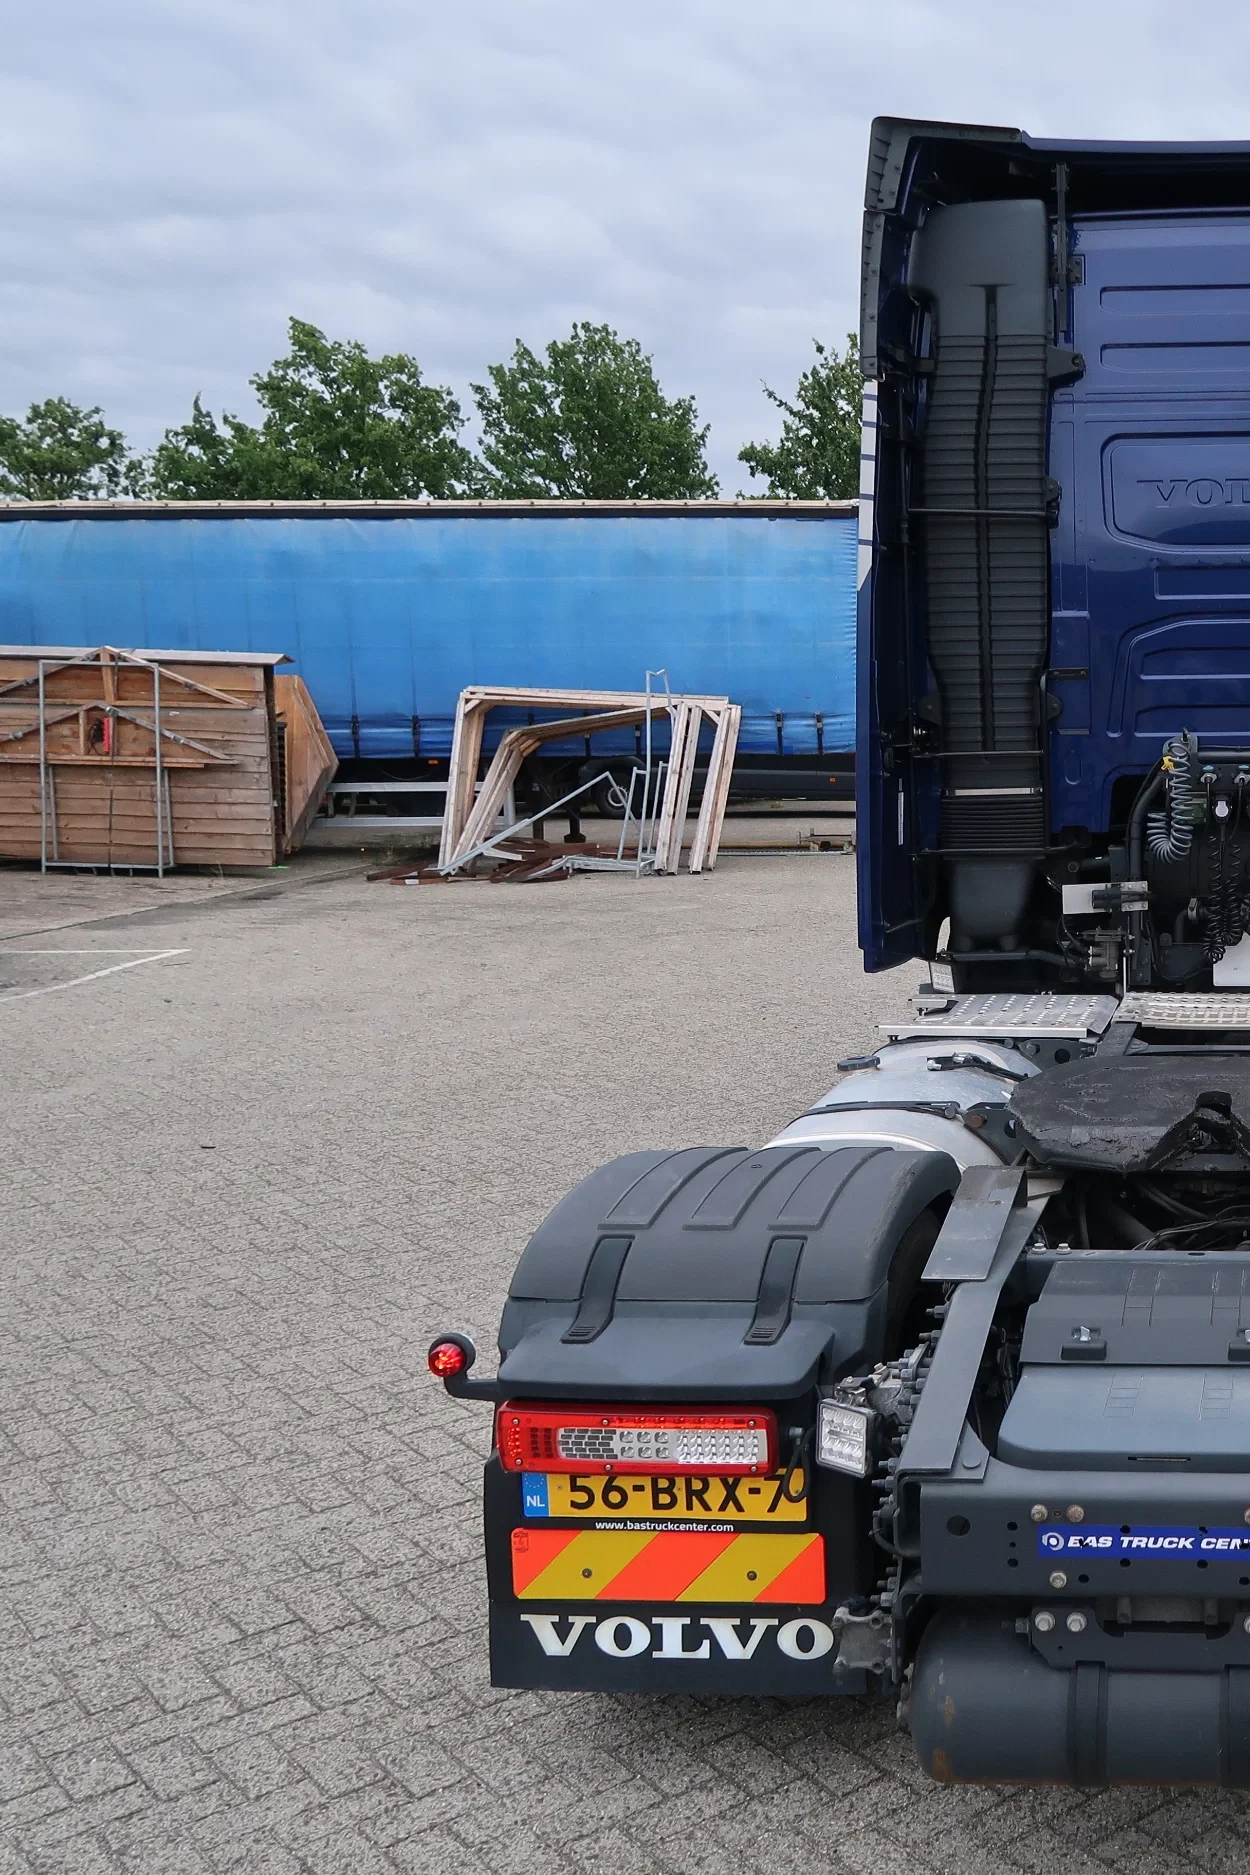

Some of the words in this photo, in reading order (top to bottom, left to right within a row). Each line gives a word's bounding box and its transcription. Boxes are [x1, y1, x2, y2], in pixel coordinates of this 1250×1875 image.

[526, 1495, 545, 1507] NL
[595, 1521, 734, 1532] www.bastruckcenter.com
[1120, 1536, 1195, 1549] TRUCK
[520, 1614, 834, 1660] VOLVO
